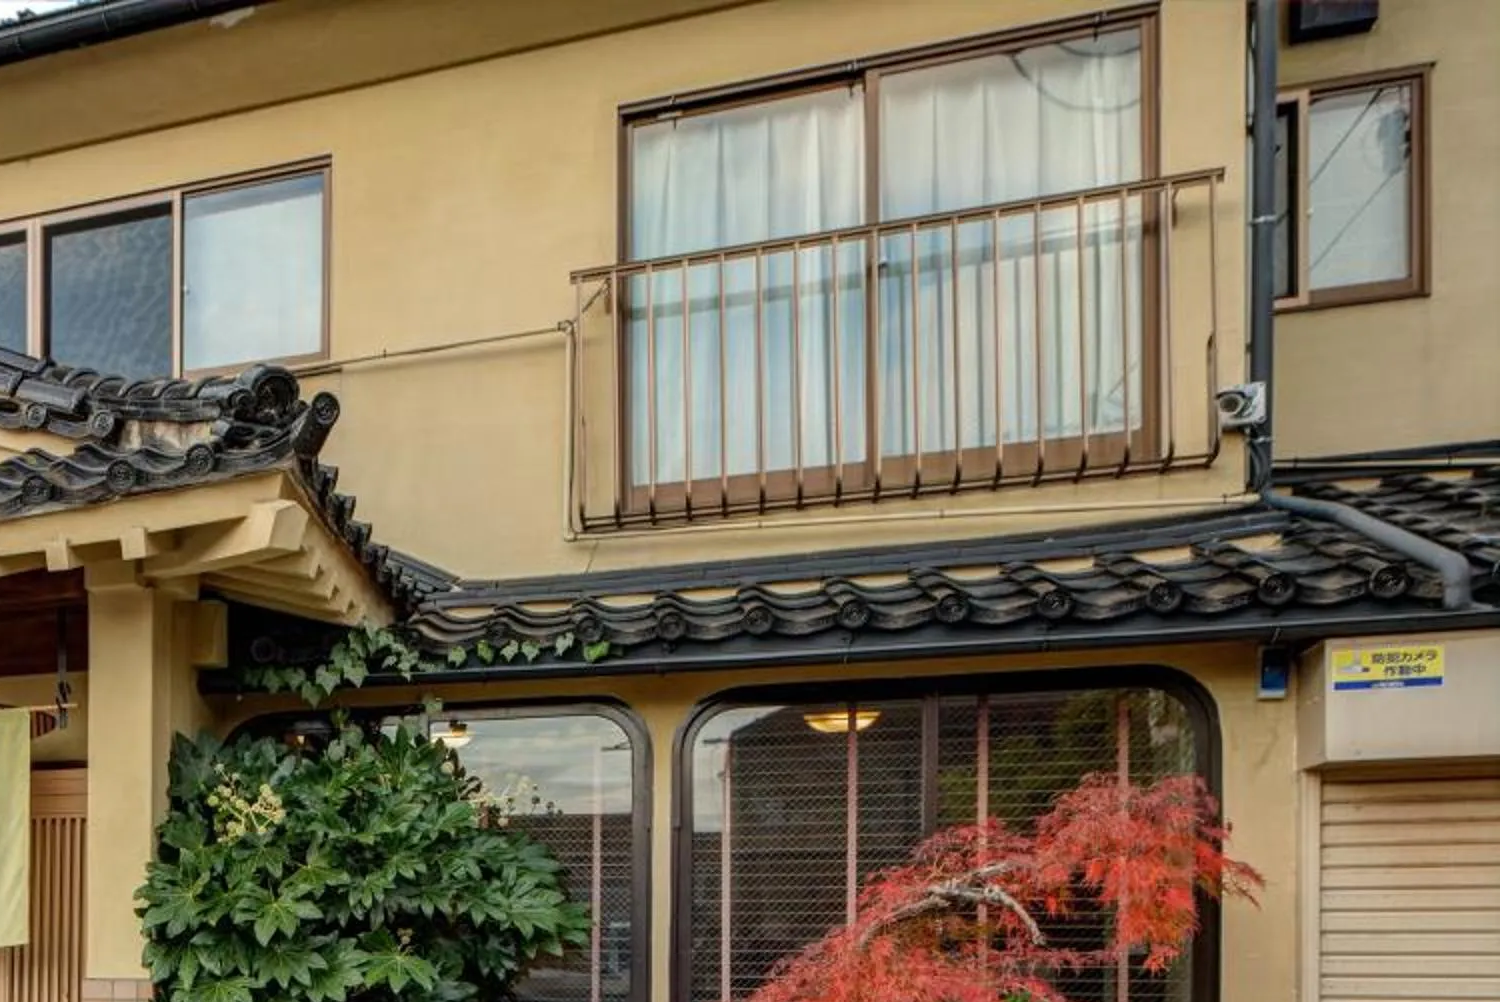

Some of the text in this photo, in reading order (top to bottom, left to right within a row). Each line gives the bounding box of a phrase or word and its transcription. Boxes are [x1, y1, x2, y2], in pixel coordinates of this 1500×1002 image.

[1372, 649, 1438, 664] 防犯カメラ
